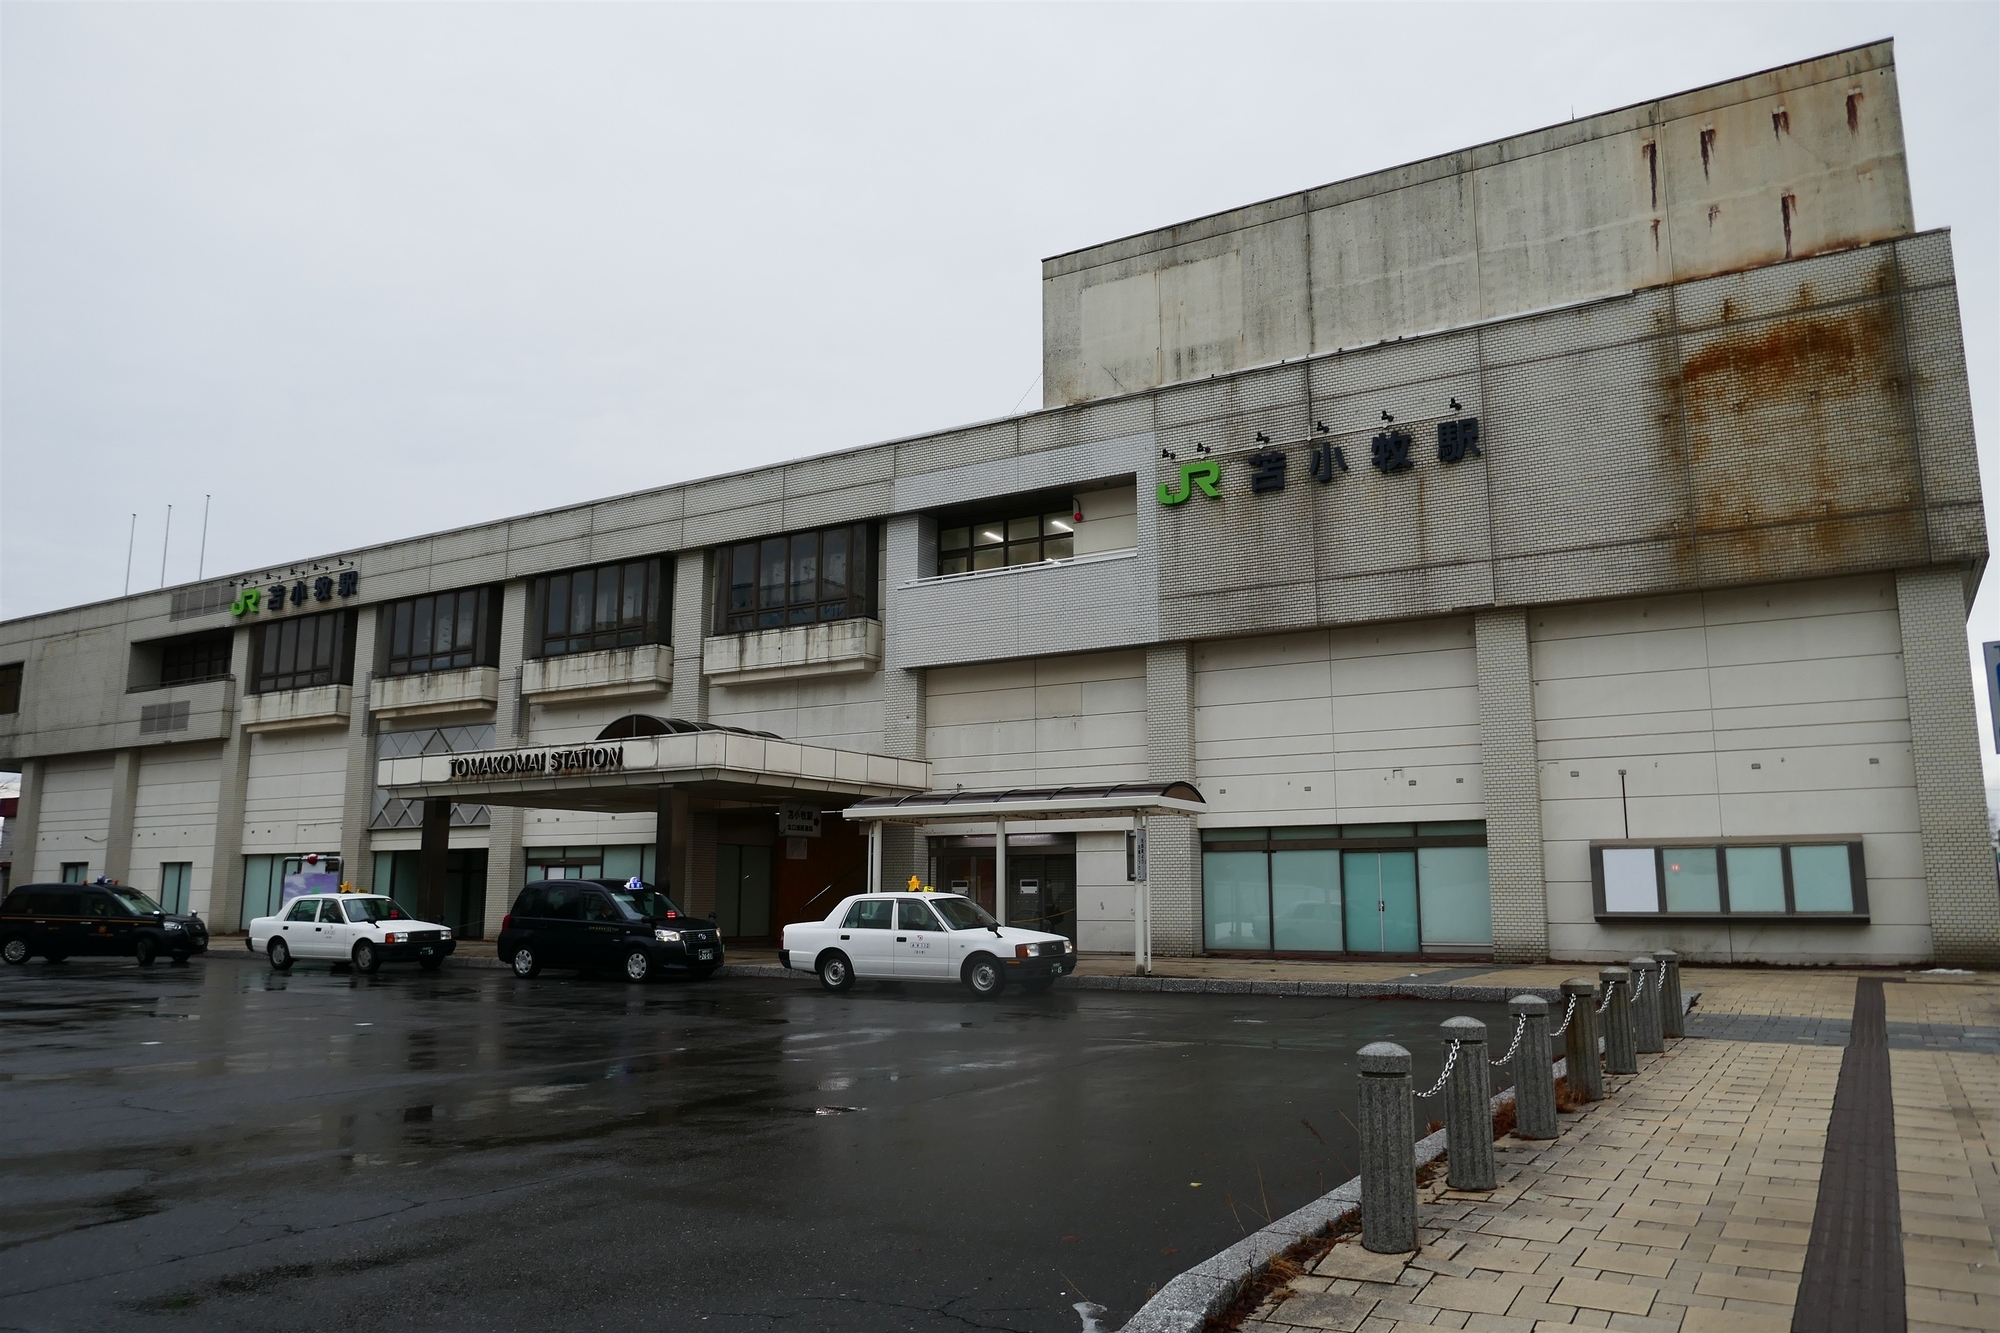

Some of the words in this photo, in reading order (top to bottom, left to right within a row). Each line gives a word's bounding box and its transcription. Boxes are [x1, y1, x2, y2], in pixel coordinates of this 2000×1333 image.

[1157, 461, 1221, 504] JR
[1251, 417, 1481, 493] 苫小牧駅
[231, 588, 261, 616] JR
[268, 571, 358, 610] 苫小牧駅
[449, 752, 547, 777] TOMAKOMAI
[550, 745, 624, 771] STATION
